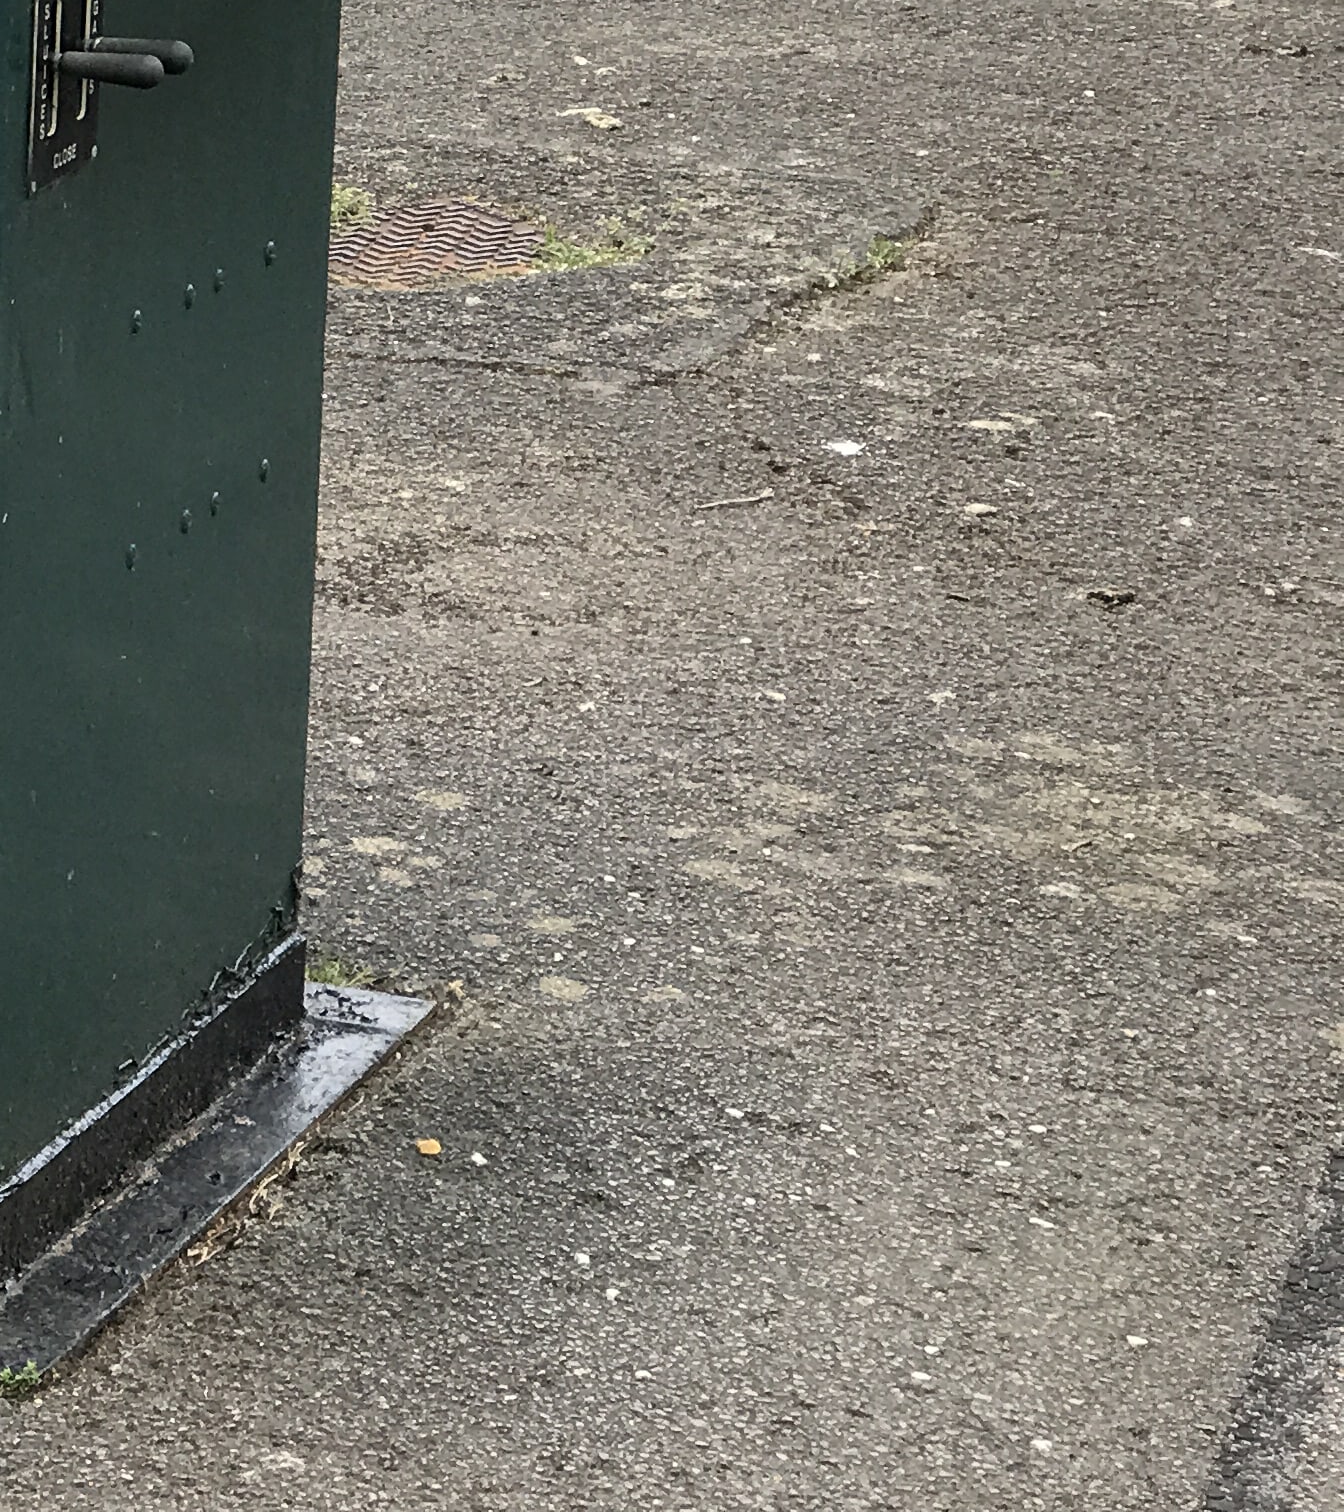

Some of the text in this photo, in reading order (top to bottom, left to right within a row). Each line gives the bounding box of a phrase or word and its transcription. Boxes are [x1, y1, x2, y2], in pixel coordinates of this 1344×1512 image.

[39, 3, 51, 140] SLUICES
[88, 0, 99, 95] GAS
[53, 143, 77, 169] CLOSE
